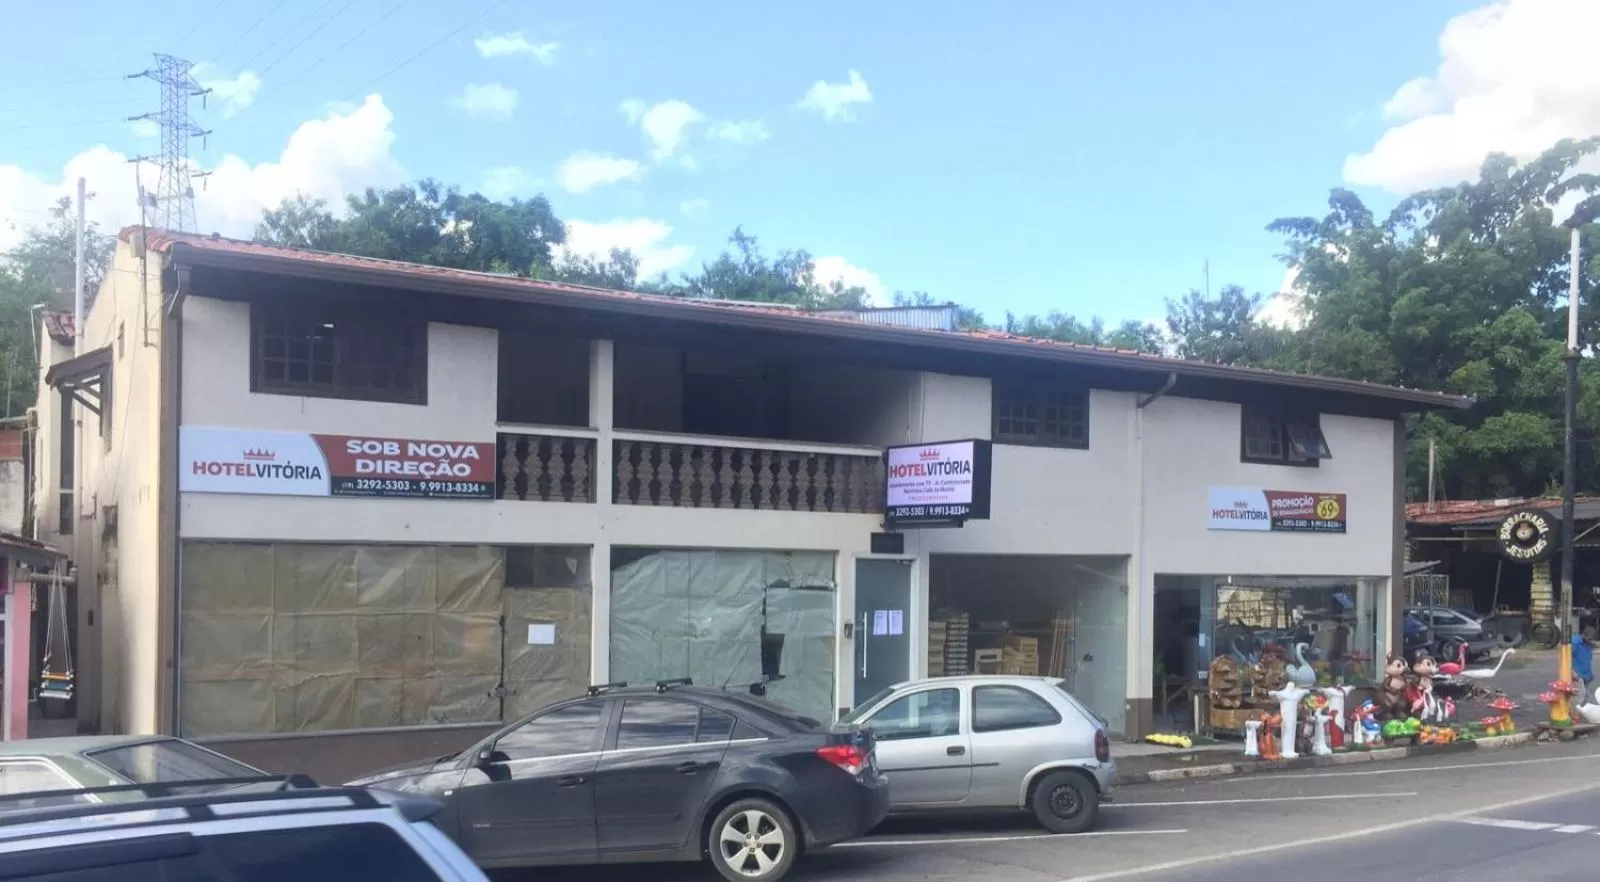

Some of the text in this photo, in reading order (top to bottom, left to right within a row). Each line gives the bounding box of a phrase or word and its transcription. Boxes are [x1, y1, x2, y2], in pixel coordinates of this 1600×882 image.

[346, 439, 480, 459] SOB NOVA
[355, 458, 472, 479] DIREÇÃO
[356, 479, 410, 491] 3292-5303
[419, 481, 479, 493] 9.9913-8334
[1271, 495, 1314, 509] PROMOÇÃO
[1321, 502, 1334, 517] 69
[1500, 512, 1549, 540] BORRACHARIA
